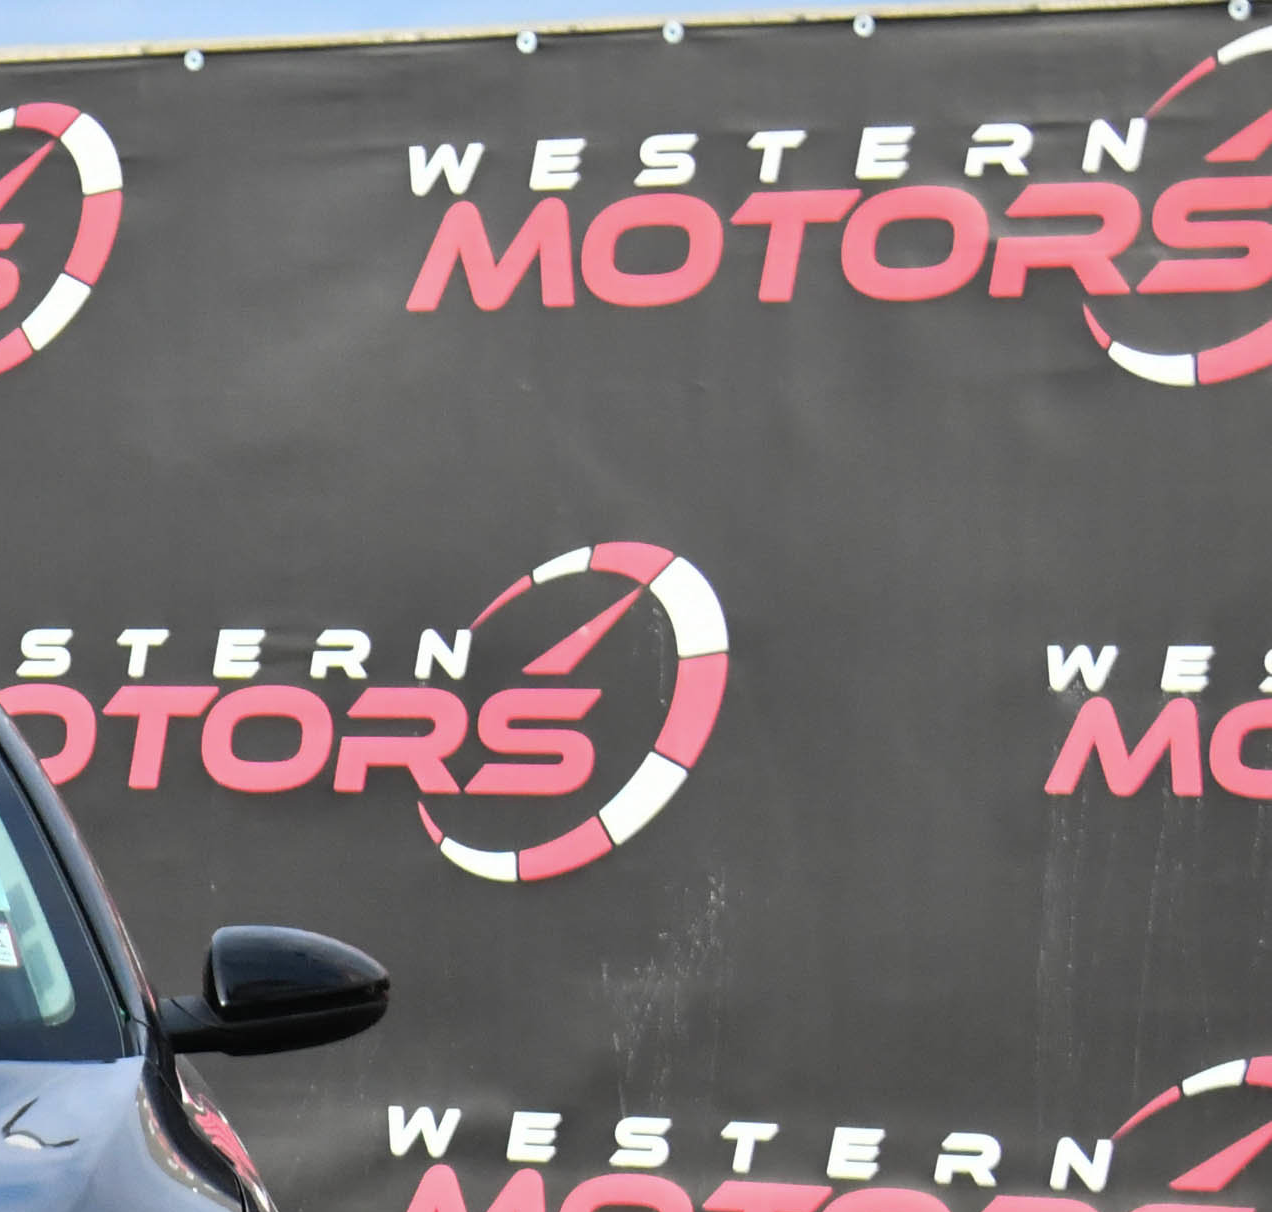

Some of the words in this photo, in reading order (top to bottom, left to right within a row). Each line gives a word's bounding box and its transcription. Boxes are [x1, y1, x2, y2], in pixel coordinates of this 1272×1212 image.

[408, 118, 1147, 196] WESTERN
[406, 175, 1272, 312] MOTORS
[387, 1104, 1114, 1192] WESTERN
